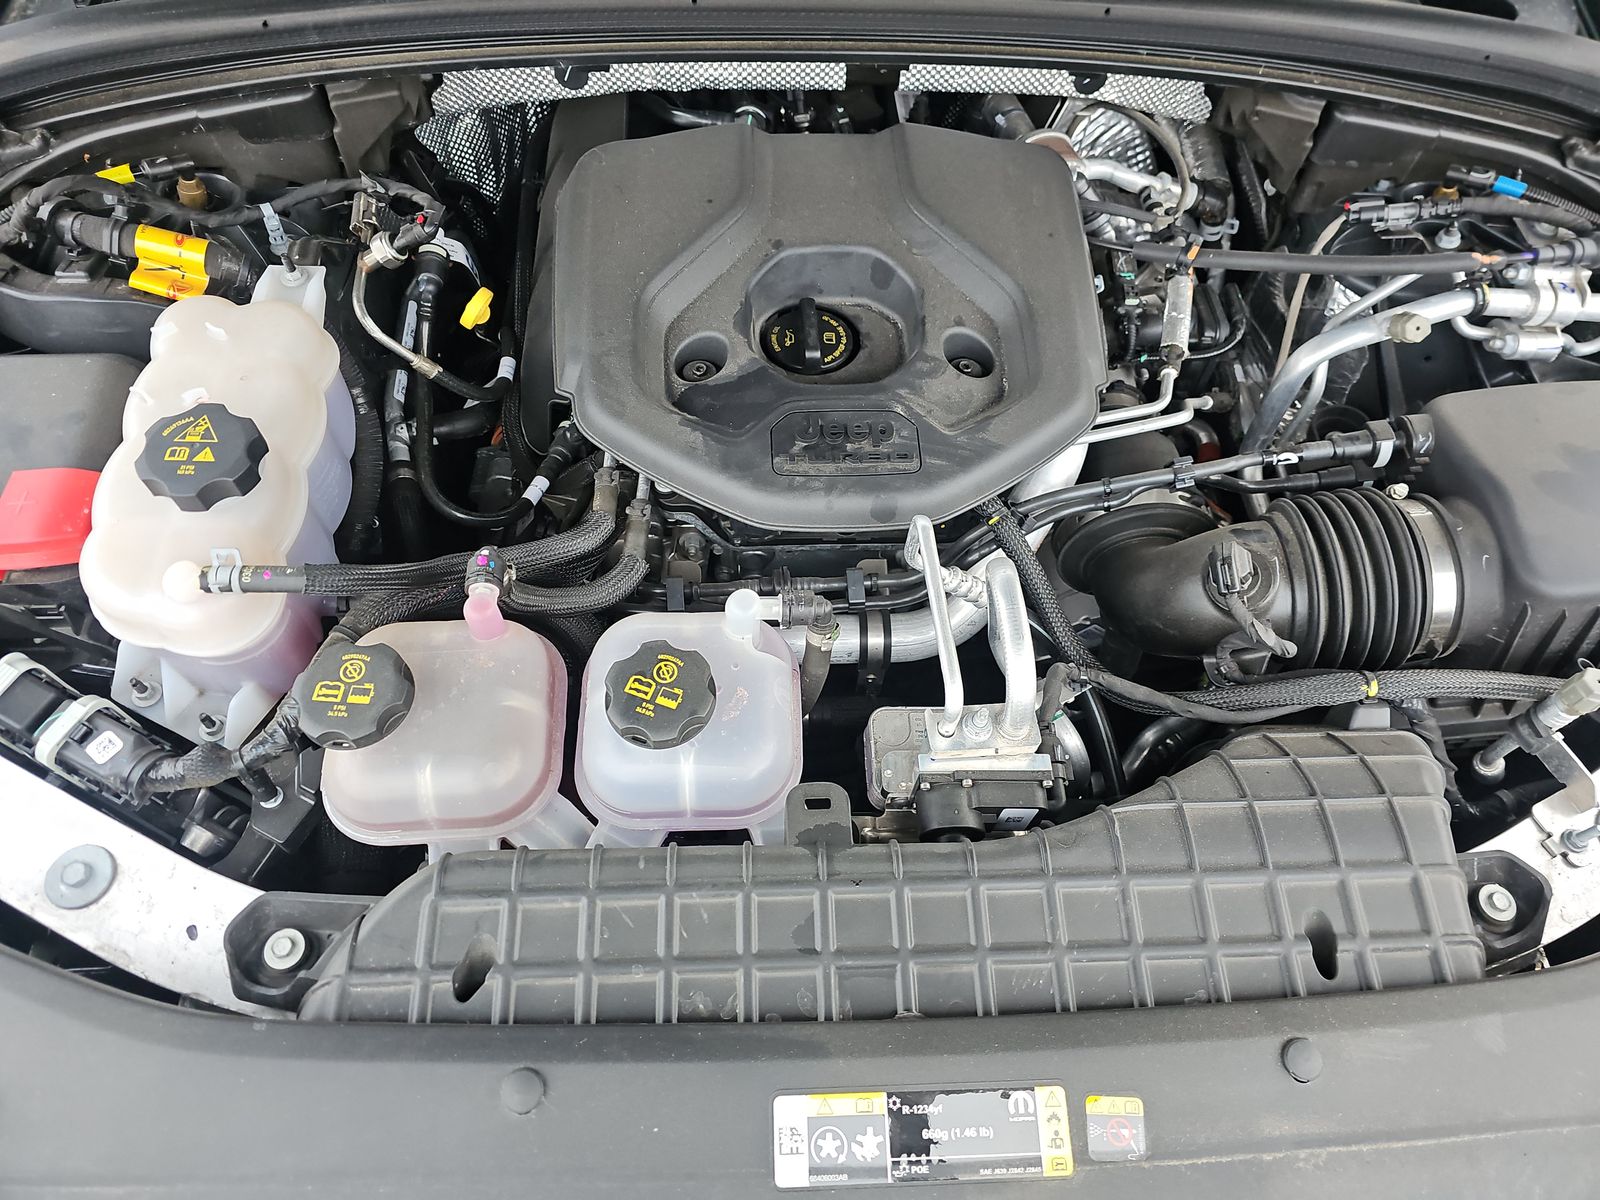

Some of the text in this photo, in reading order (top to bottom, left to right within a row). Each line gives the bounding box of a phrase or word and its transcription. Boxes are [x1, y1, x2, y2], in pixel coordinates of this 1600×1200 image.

[794, 413, 896, 448] Jeep
[901, 1103, 944, 1115] R-1234yf
[921, 1126, 994, 1142] 660g (1.46 lb)
[911, 1165, 930, 1175] POE
[979, 1168, 993, 1176] SAE
